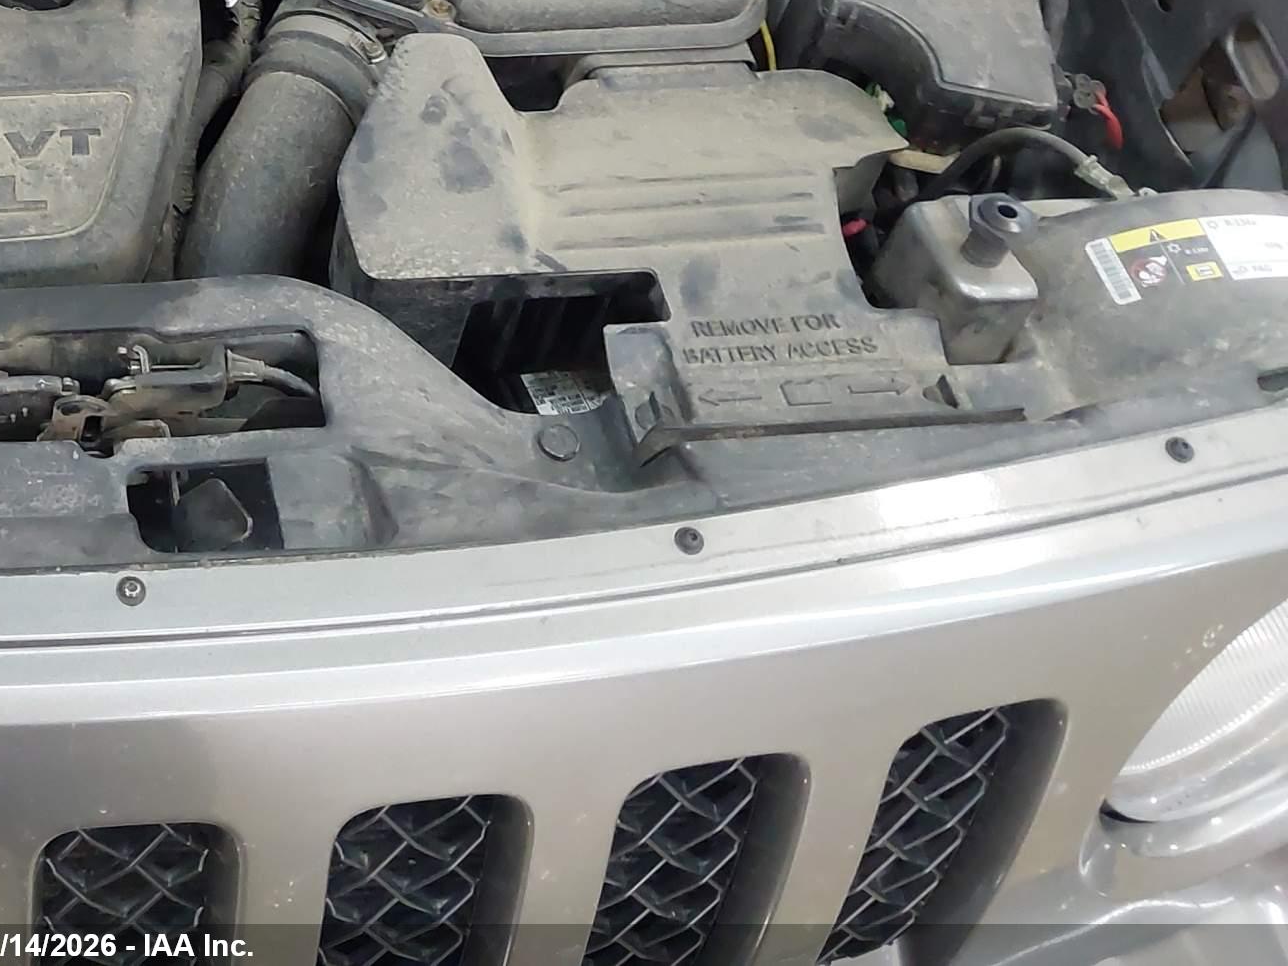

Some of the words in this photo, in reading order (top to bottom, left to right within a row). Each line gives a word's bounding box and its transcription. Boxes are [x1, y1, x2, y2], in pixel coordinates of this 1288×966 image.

[691, 318, 784, 338] REMOVE
[791, 313, 841, 332] FOR
[683, 345, 776, 364] BATTERY
[788, 337, 879, 359] ACCESS
